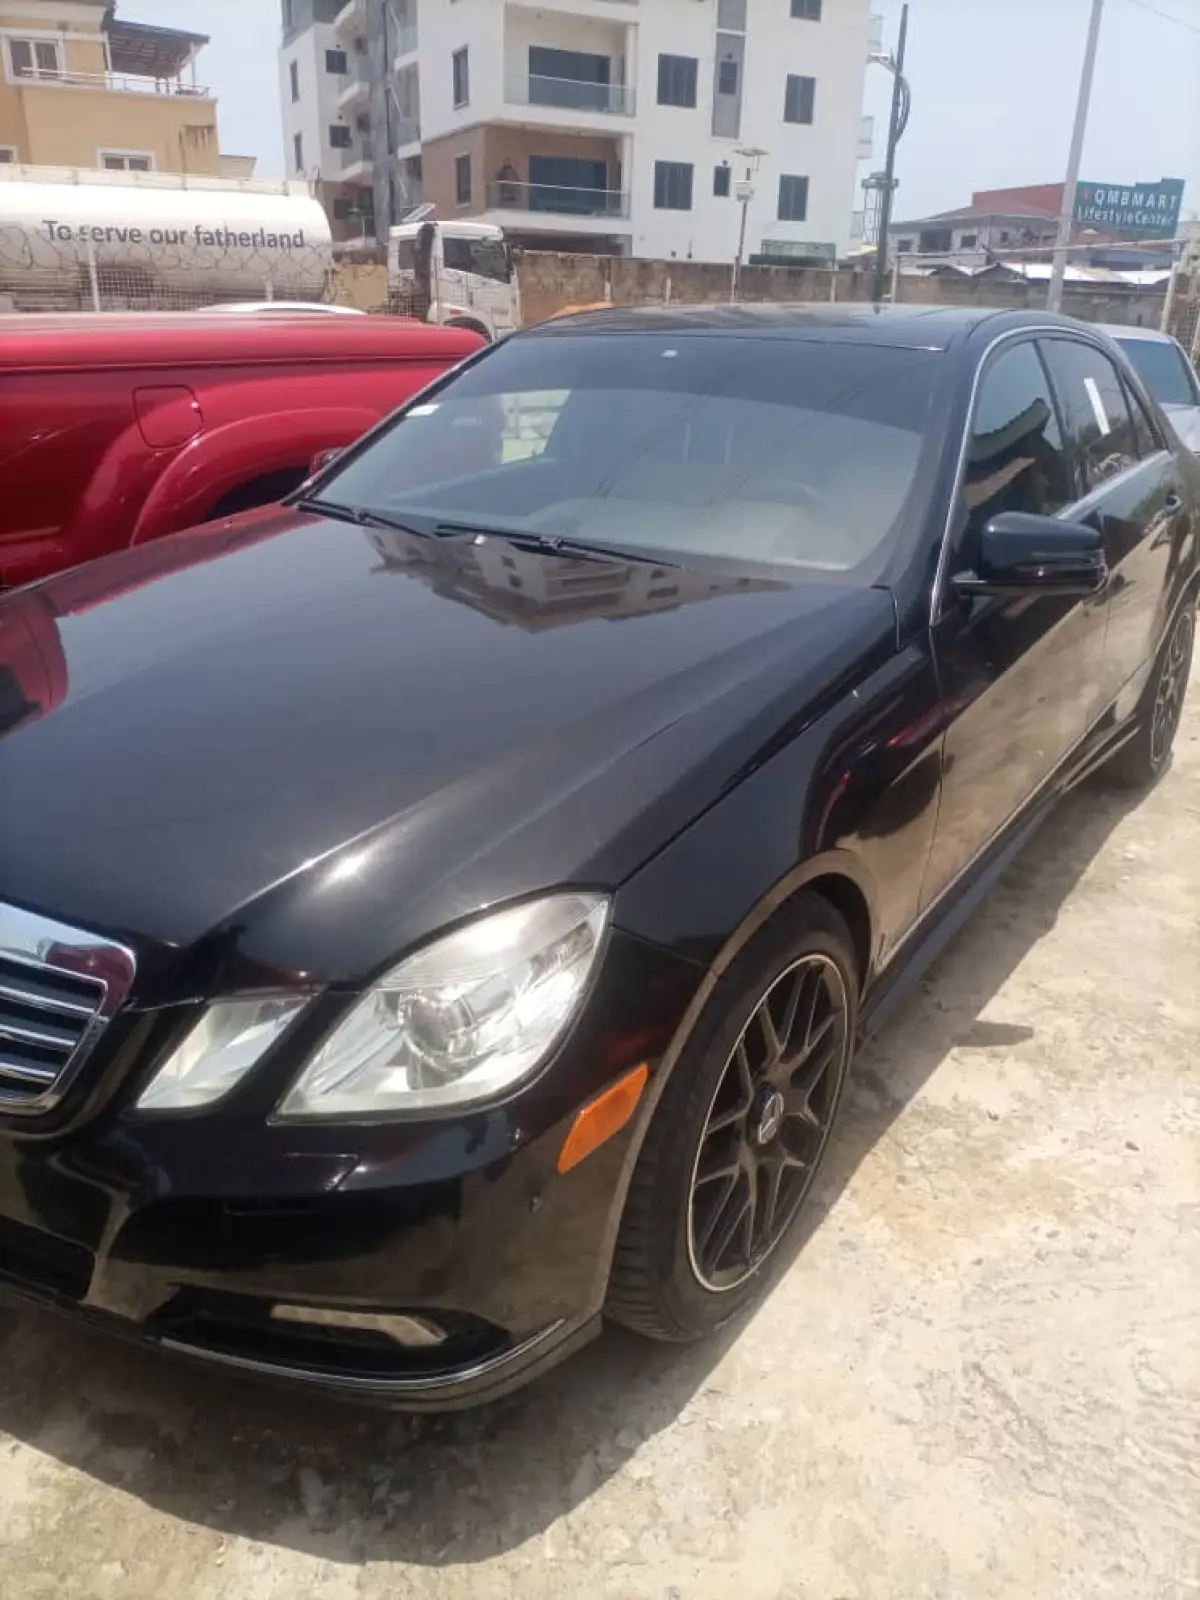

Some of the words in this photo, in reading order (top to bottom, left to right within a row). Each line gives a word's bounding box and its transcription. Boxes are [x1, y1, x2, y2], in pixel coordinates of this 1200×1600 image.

[41, 219, 72, 241] To
[78, 225, 142, 244] serve
[149, 228, 188, 245] our
[193, 223, 305, 248] fatherland
